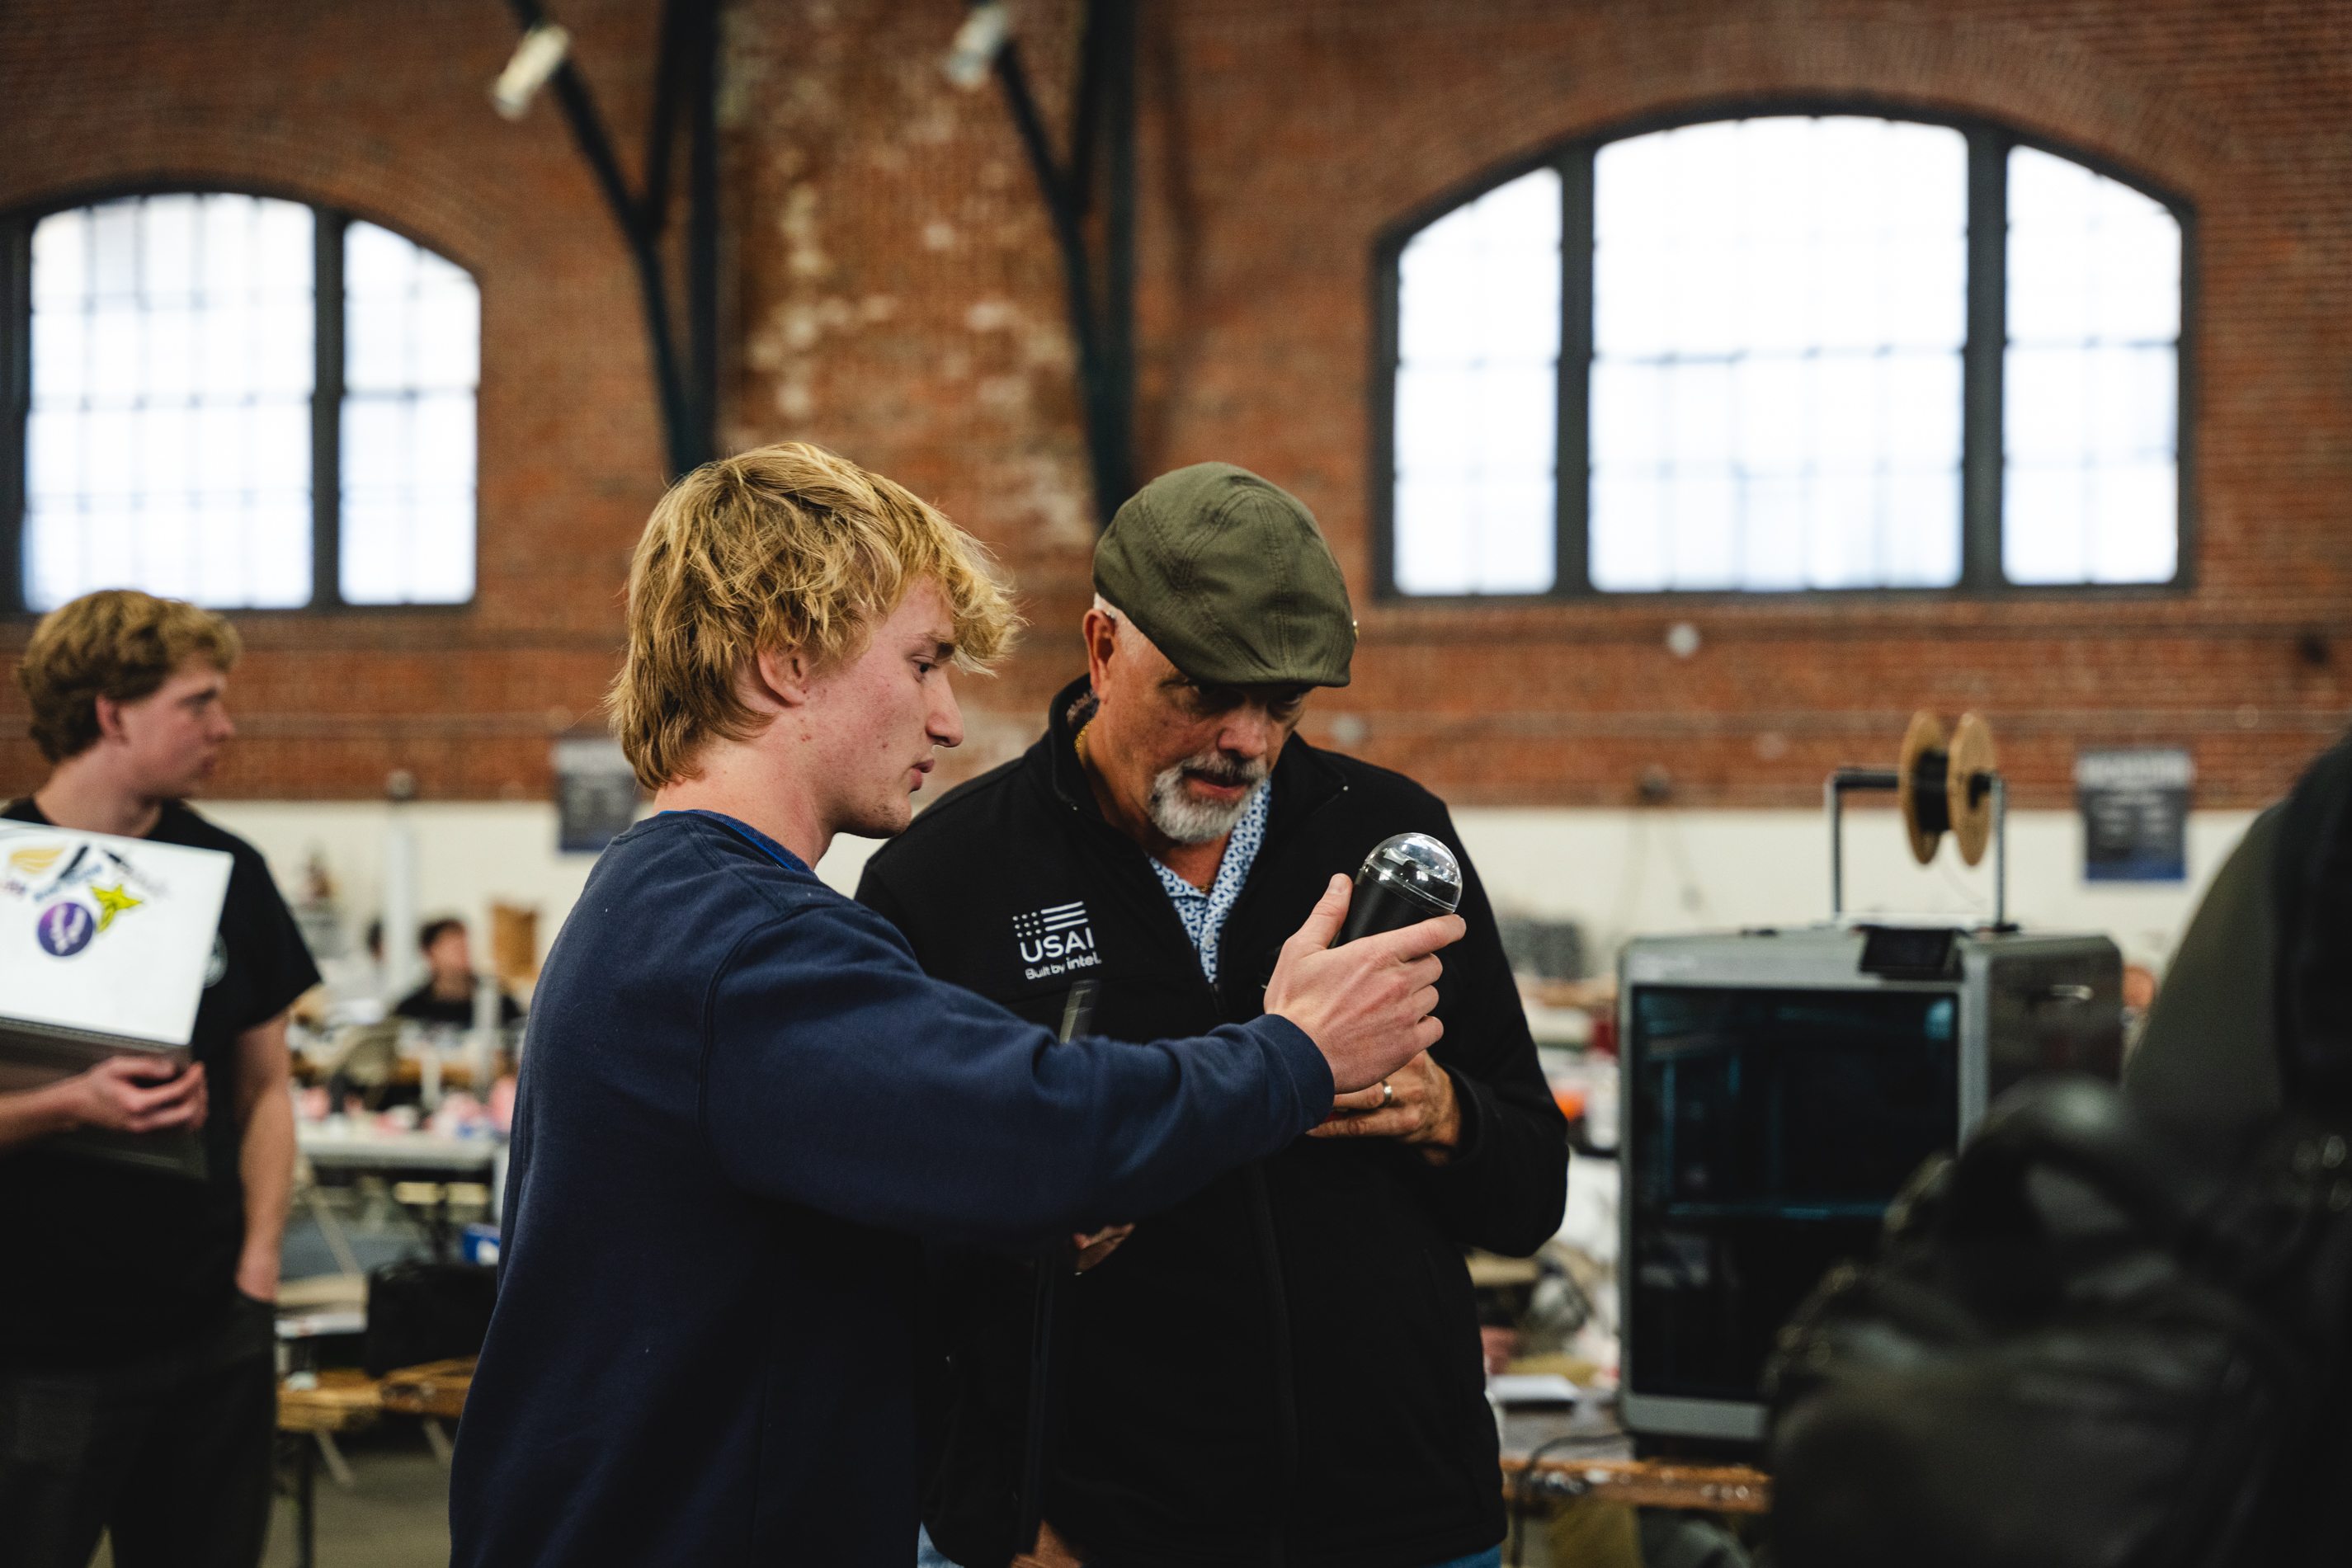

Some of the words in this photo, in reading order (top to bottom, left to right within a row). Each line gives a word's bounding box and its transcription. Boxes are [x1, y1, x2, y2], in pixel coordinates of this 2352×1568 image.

[1020, 927, 1095, 963] USAI
[1025, 966, 1051, 980] Built
[1050, 963, 1065, 974] by
